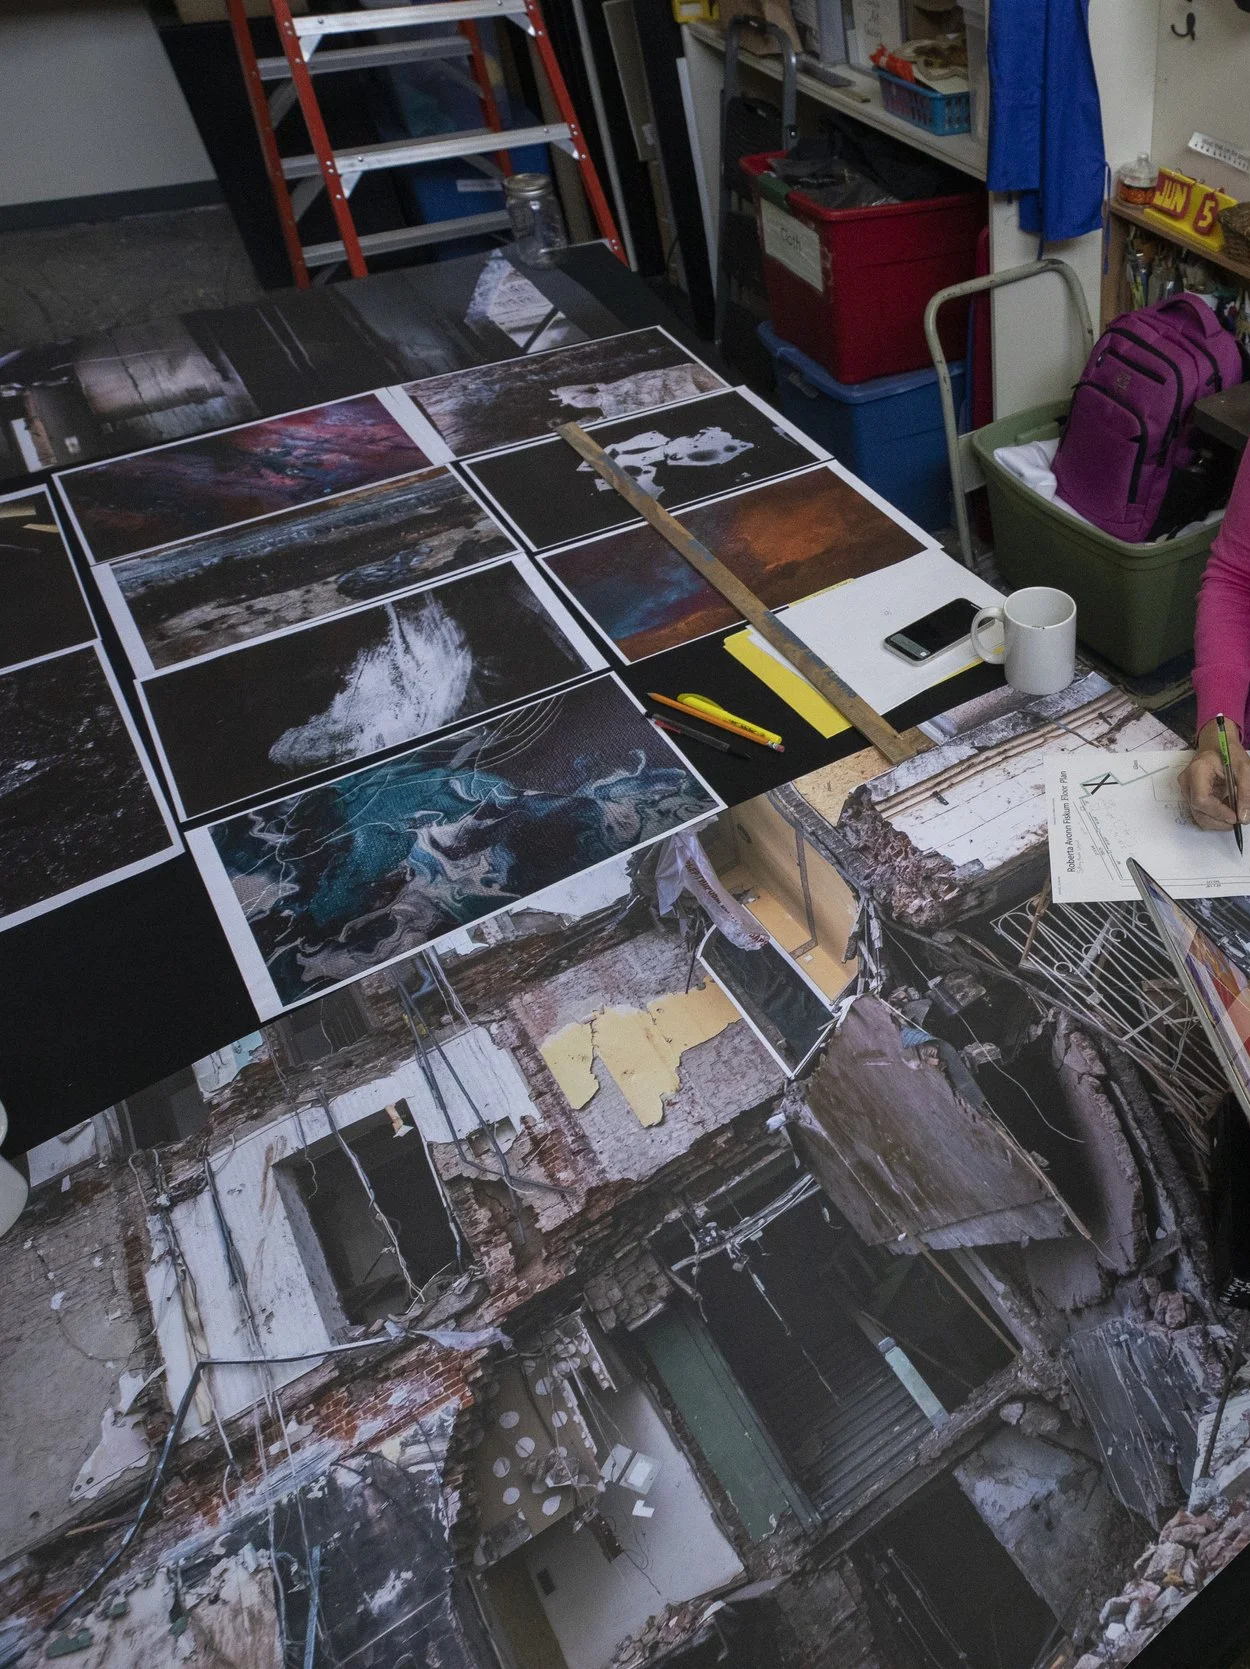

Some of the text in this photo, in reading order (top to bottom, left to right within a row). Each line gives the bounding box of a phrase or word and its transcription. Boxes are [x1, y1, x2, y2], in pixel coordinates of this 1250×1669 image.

[1153, 180, 1216, 228] JUN 5
[1058, 770, 1068, 784] Plan
[1060, 784, 1069, 802] Floor
[1066, 847, 1077, 873] Roberta
